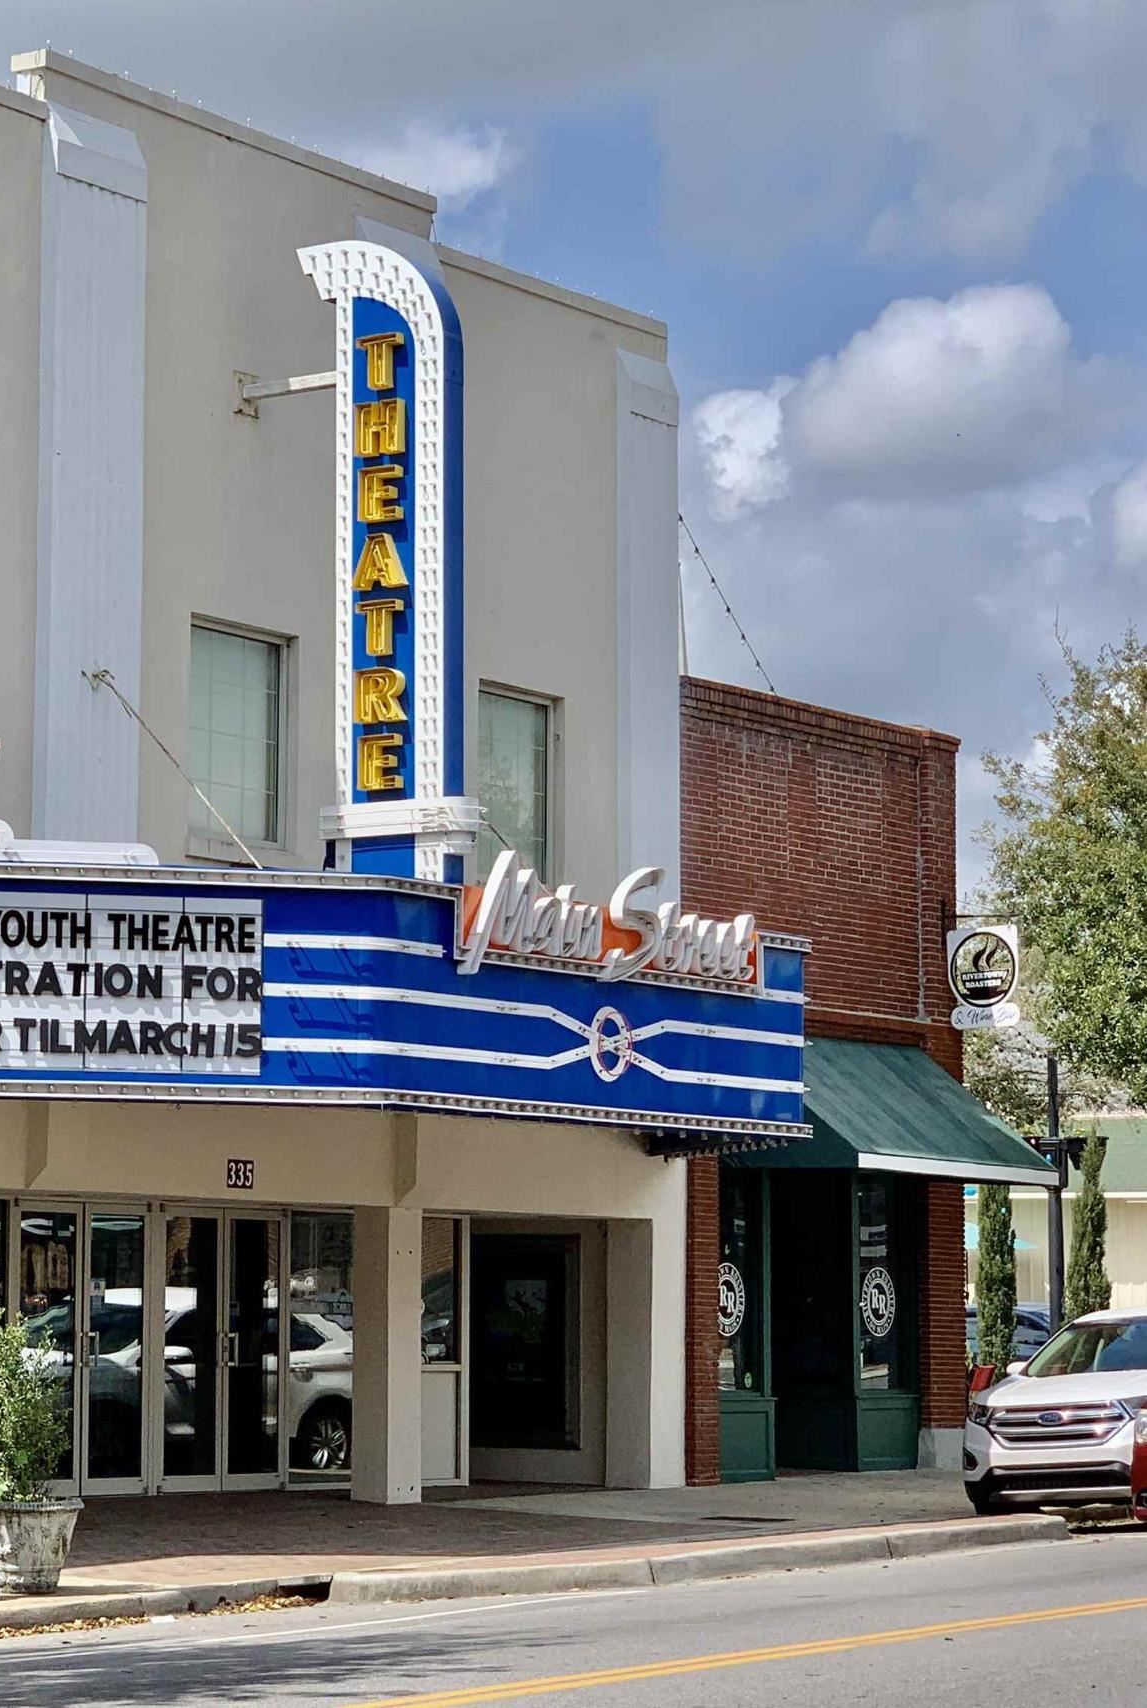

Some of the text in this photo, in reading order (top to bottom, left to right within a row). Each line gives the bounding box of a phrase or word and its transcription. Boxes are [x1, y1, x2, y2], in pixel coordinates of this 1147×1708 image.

[352, 331, 409, 792] THEATRE
[457, 850, 756, 982] Main Street
[108, 913, 256, 953] THEATRE
[182, 965, 263, 1002] FOR
[954, 1010, 964, 1025] &
[228, 1162, 253, 1186] 335
[719, 1285, 736, 1313] RR
[871, 1288, 887, 1315] RR
